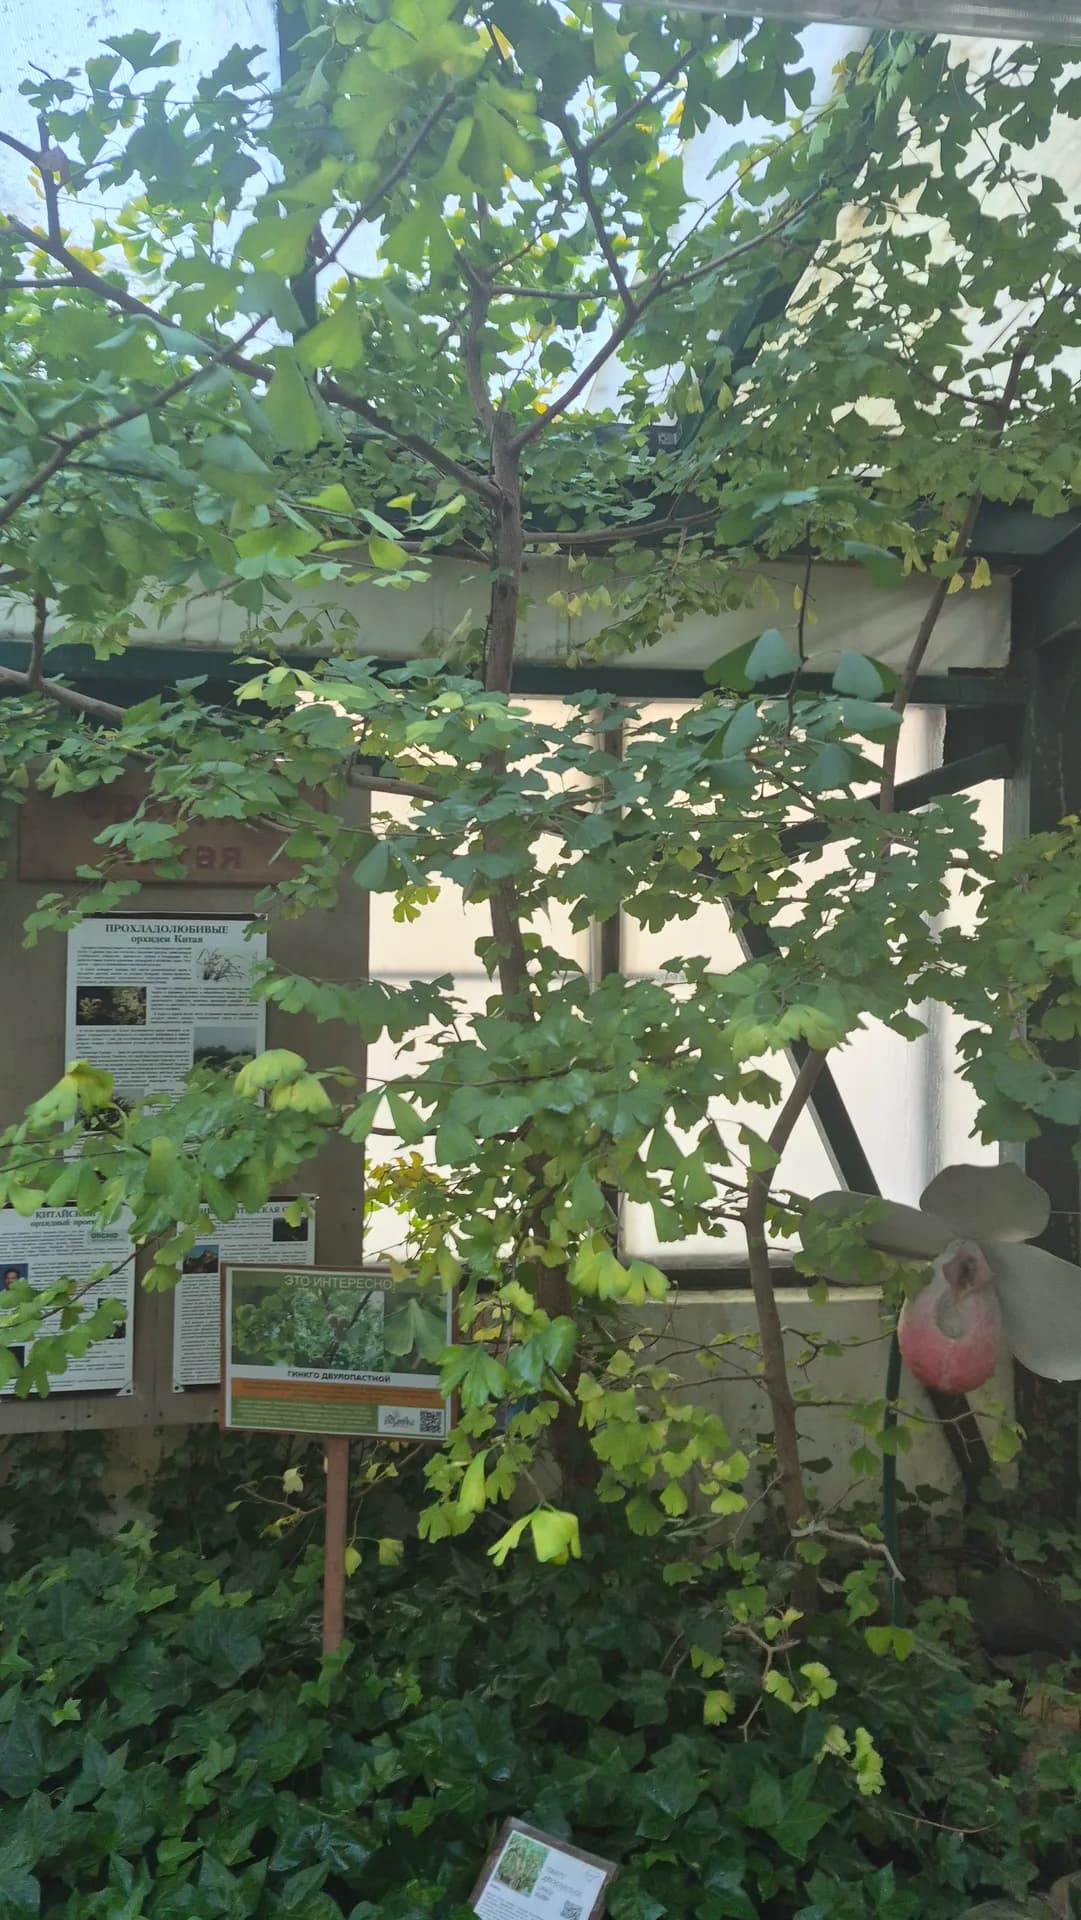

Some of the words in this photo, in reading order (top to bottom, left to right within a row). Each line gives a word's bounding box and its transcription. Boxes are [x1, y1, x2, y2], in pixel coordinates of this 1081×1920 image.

[105, 923, 229, 934] ПРОХЛАДОЛЮБИВЫЕ
[131, 935, 171, 944] орхидеи
[174, 935, 204, 943] Китая
[284, 1274, 310, 1286] ЭТО
[313, 1276, 396, 1291] ИНТЕРЕСНО!
[287, 1370, 319, 1379] ГИНКГО
